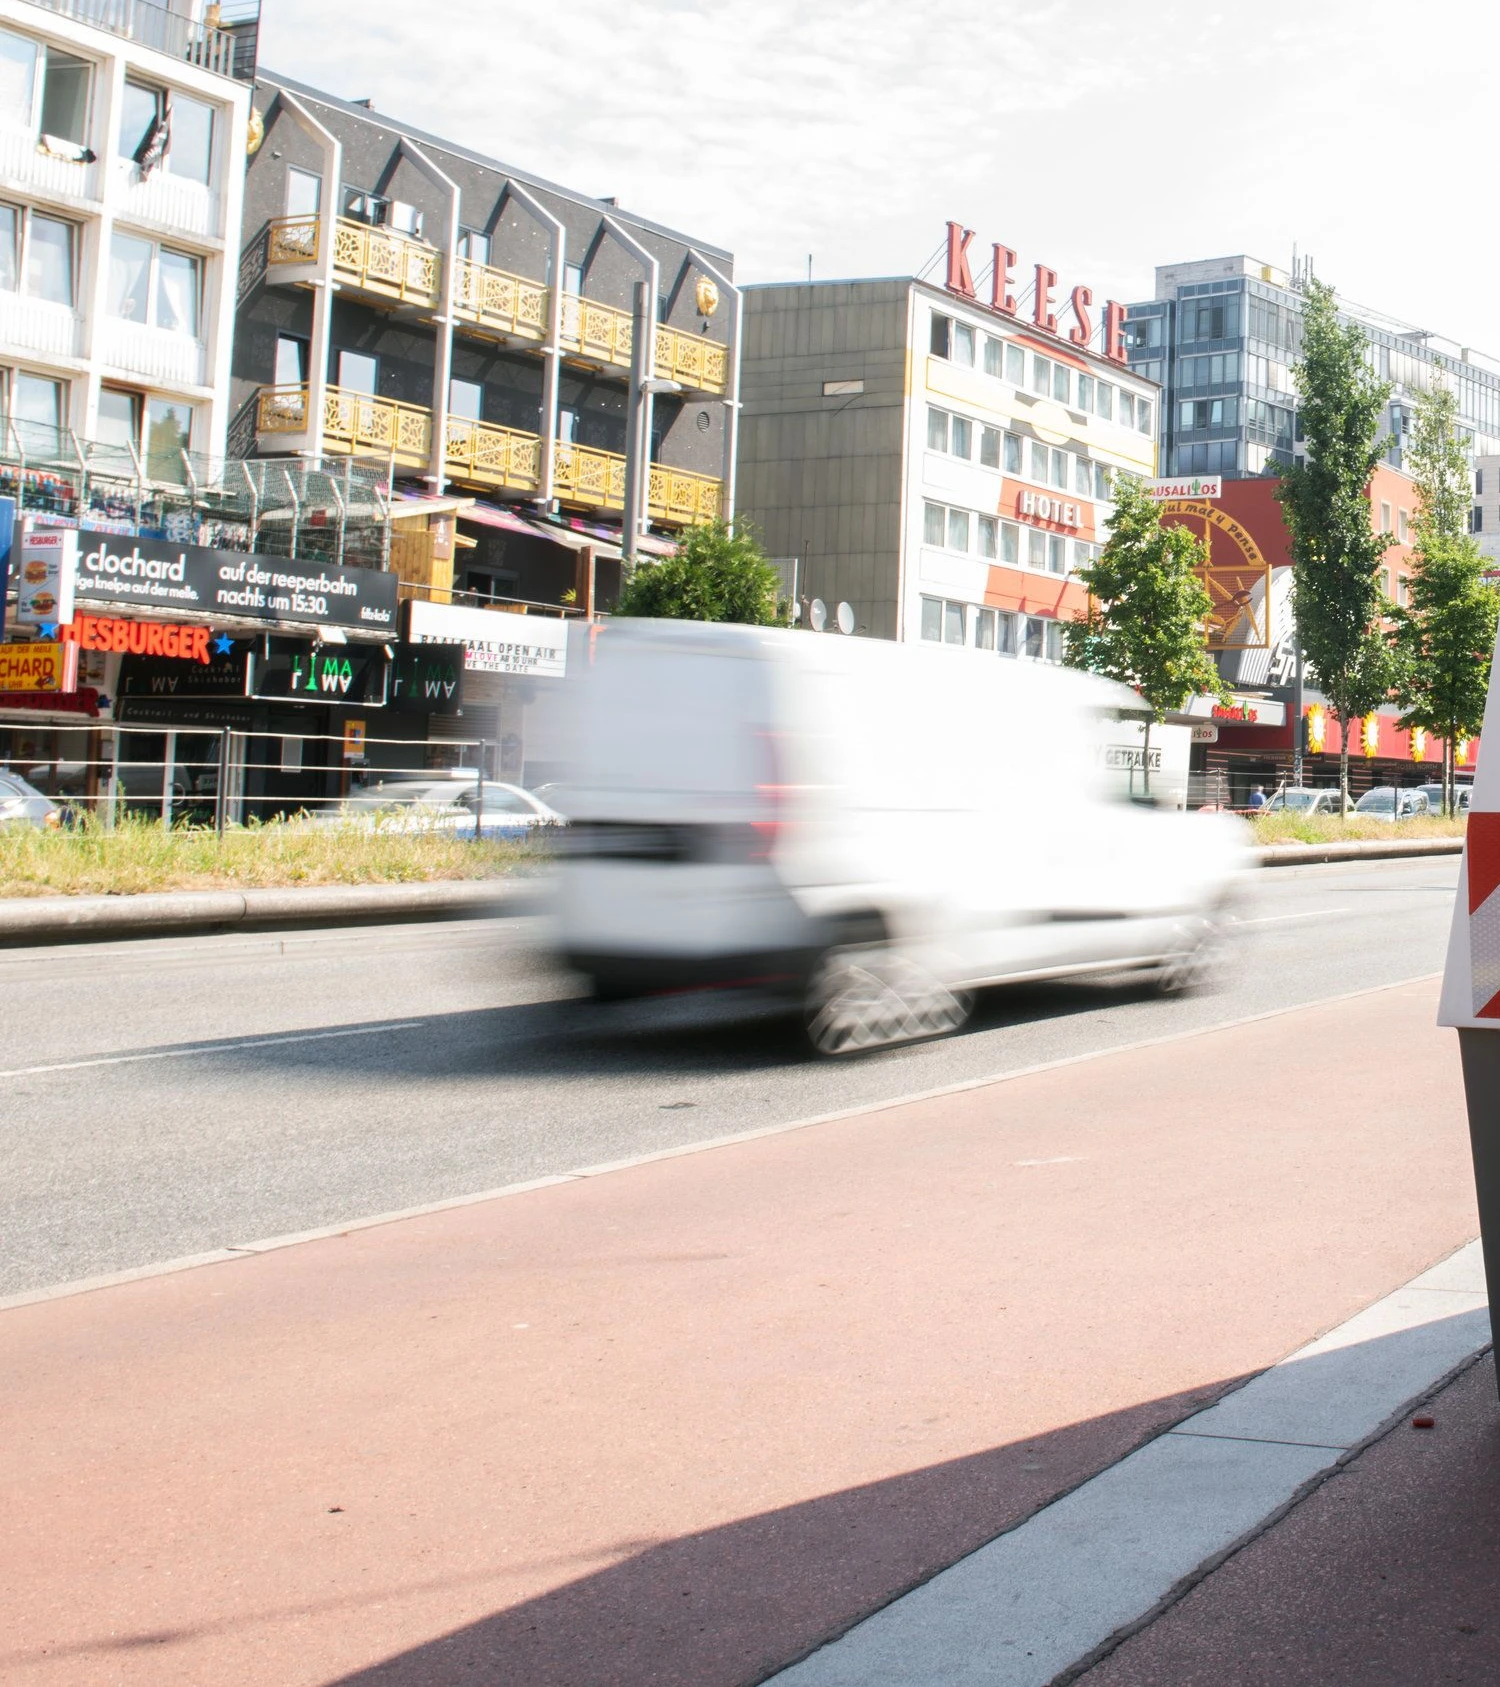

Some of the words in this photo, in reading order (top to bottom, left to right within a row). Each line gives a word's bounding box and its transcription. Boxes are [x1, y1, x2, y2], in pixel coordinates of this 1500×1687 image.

[944, 221, 1128, 366] KEESE
[1019, 489, 1084, 529] HOTEL
[86, 543, 186, 582] clochard
[132, 580, 151, 595] auf
[150, 581, 169, 597] der
[219, 562, 246, 582] auf
[246, 563, 272, 585] der
[272, 572, 358, 597] reeperbahn
[217, 586, 266, 608] nachts
[267, 596, 290, 611] um
[58, 609, 211, 665] HESBURGER
[465, 652, 498, 662] MLOVE
[498, 643, 530, 656] OPEN
[536, 647, 557, 660] AIR
[0, 657, 55, 678] CHARD
[484, 661, 499, 671] THE
[505, 662, 529, 673] DATE
